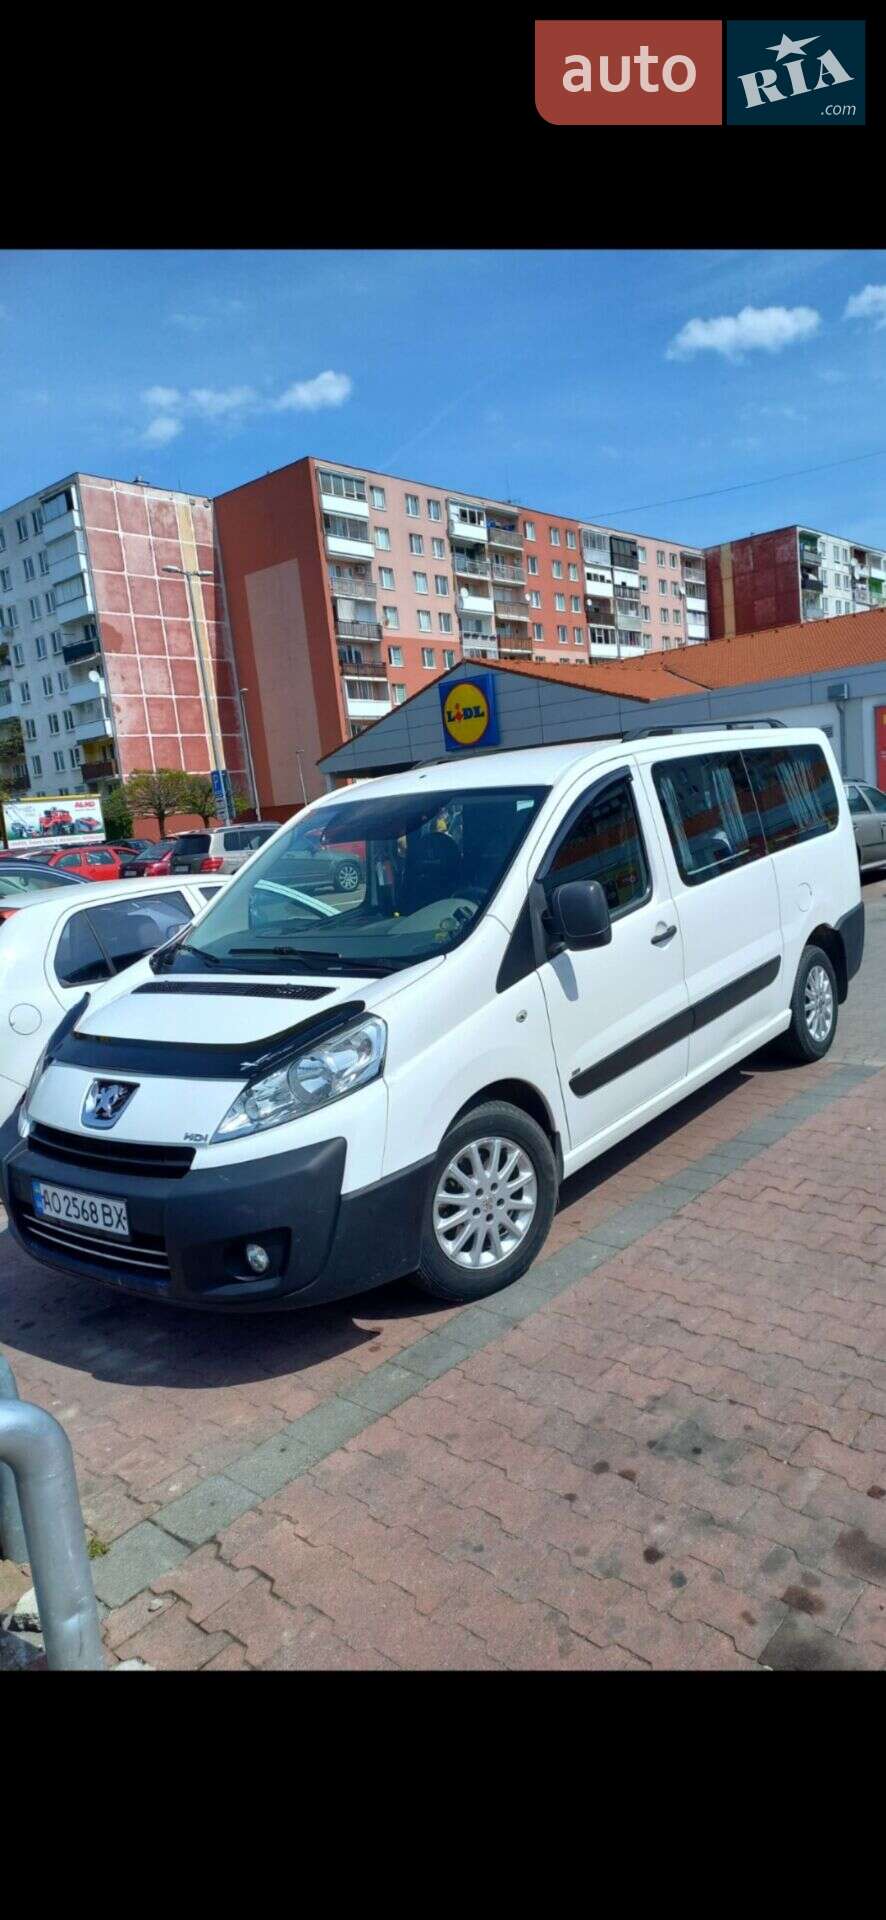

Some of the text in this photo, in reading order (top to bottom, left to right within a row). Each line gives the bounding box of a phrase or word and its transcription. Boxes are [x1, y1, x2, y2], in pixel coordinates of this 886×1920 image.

[43, 1189, 62, 1214] AO
[63, 1195, 99, 1224] 2568
[101, 1203, 127, 1232] BX
